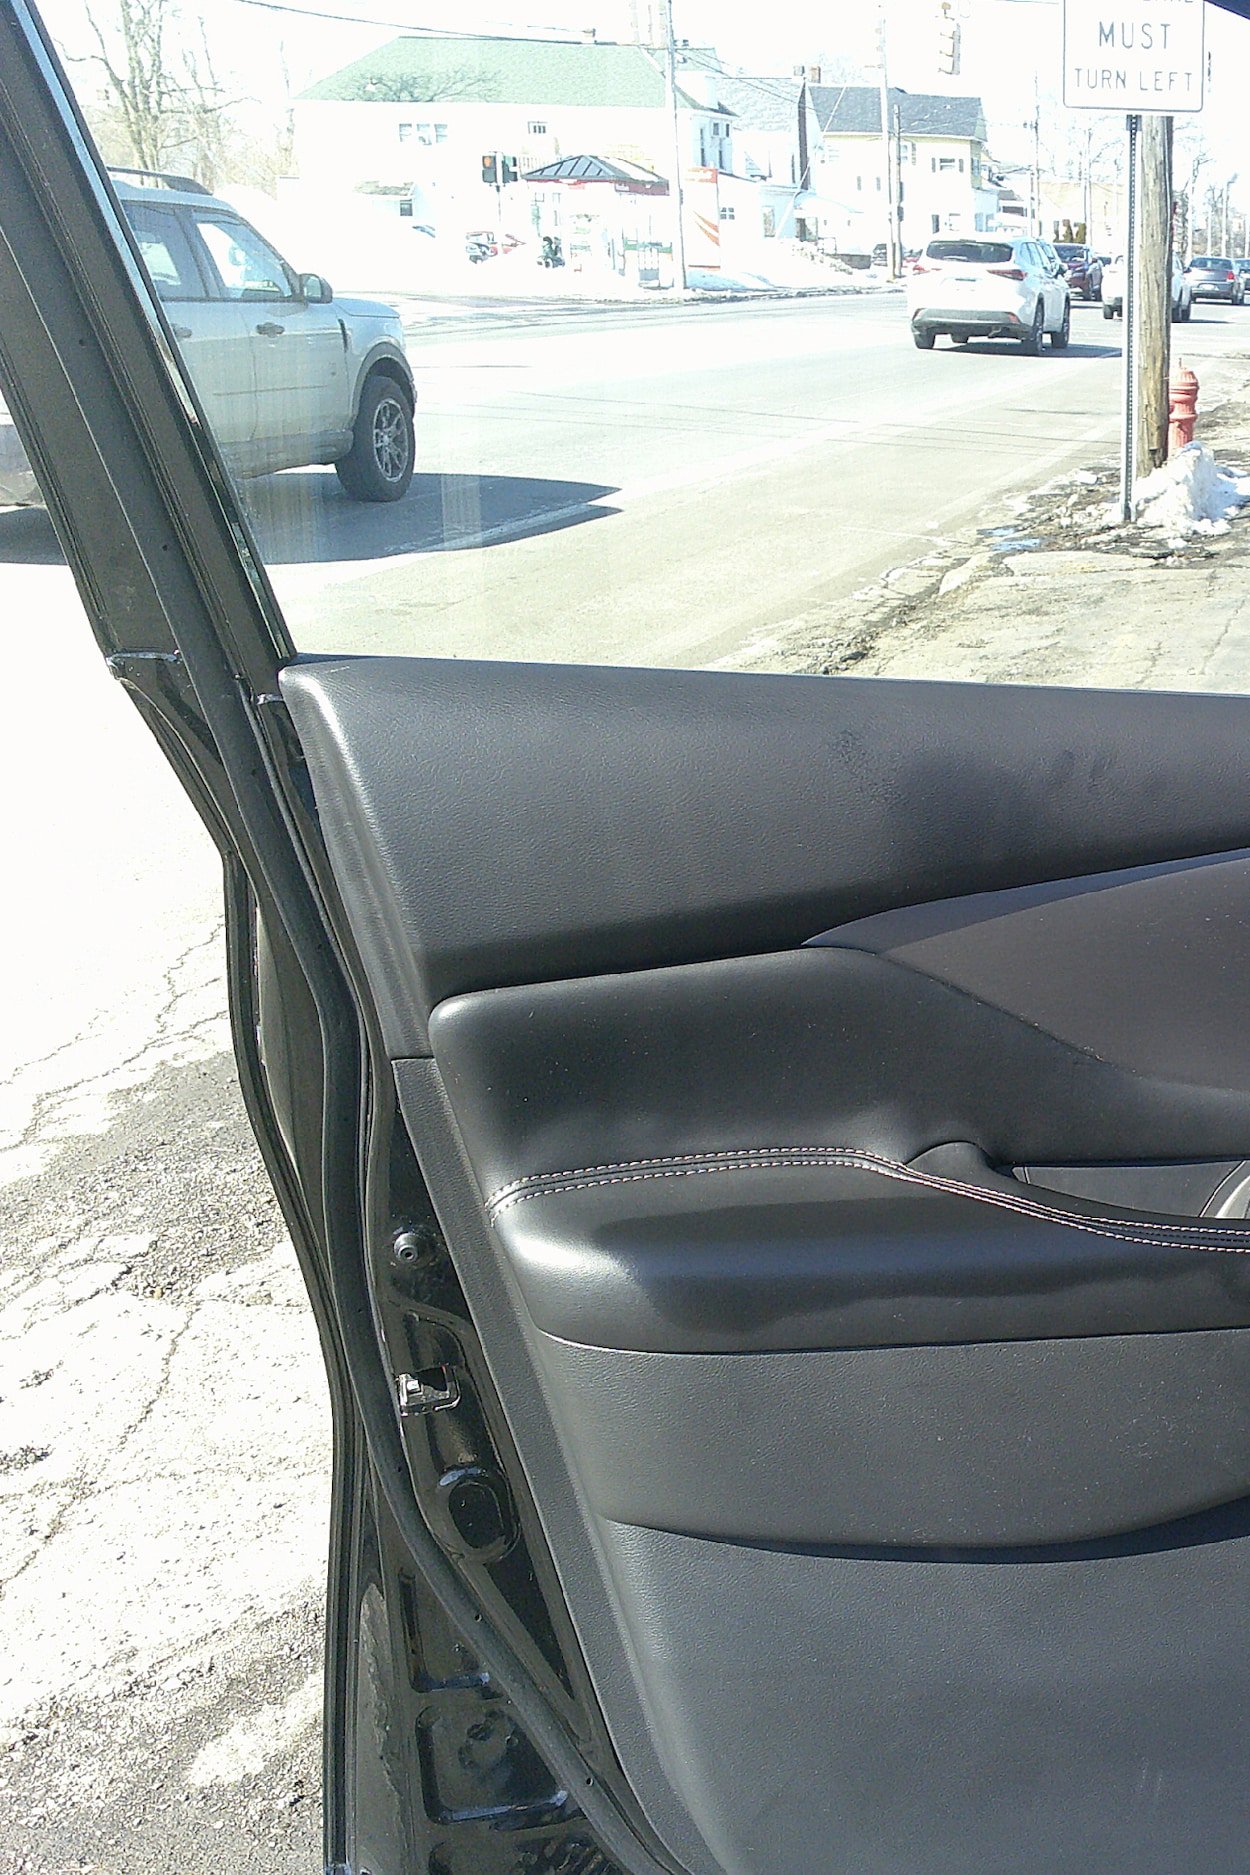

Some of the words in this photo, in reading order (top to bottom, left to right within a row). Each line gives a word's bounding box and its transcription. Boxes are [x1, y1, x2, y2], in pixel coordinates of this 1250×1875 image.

[1099, 21, 1171, 49] MUST
[1074, 68, 1127, 89] TURN
[1139, 71, 1193, 91] LEFT
